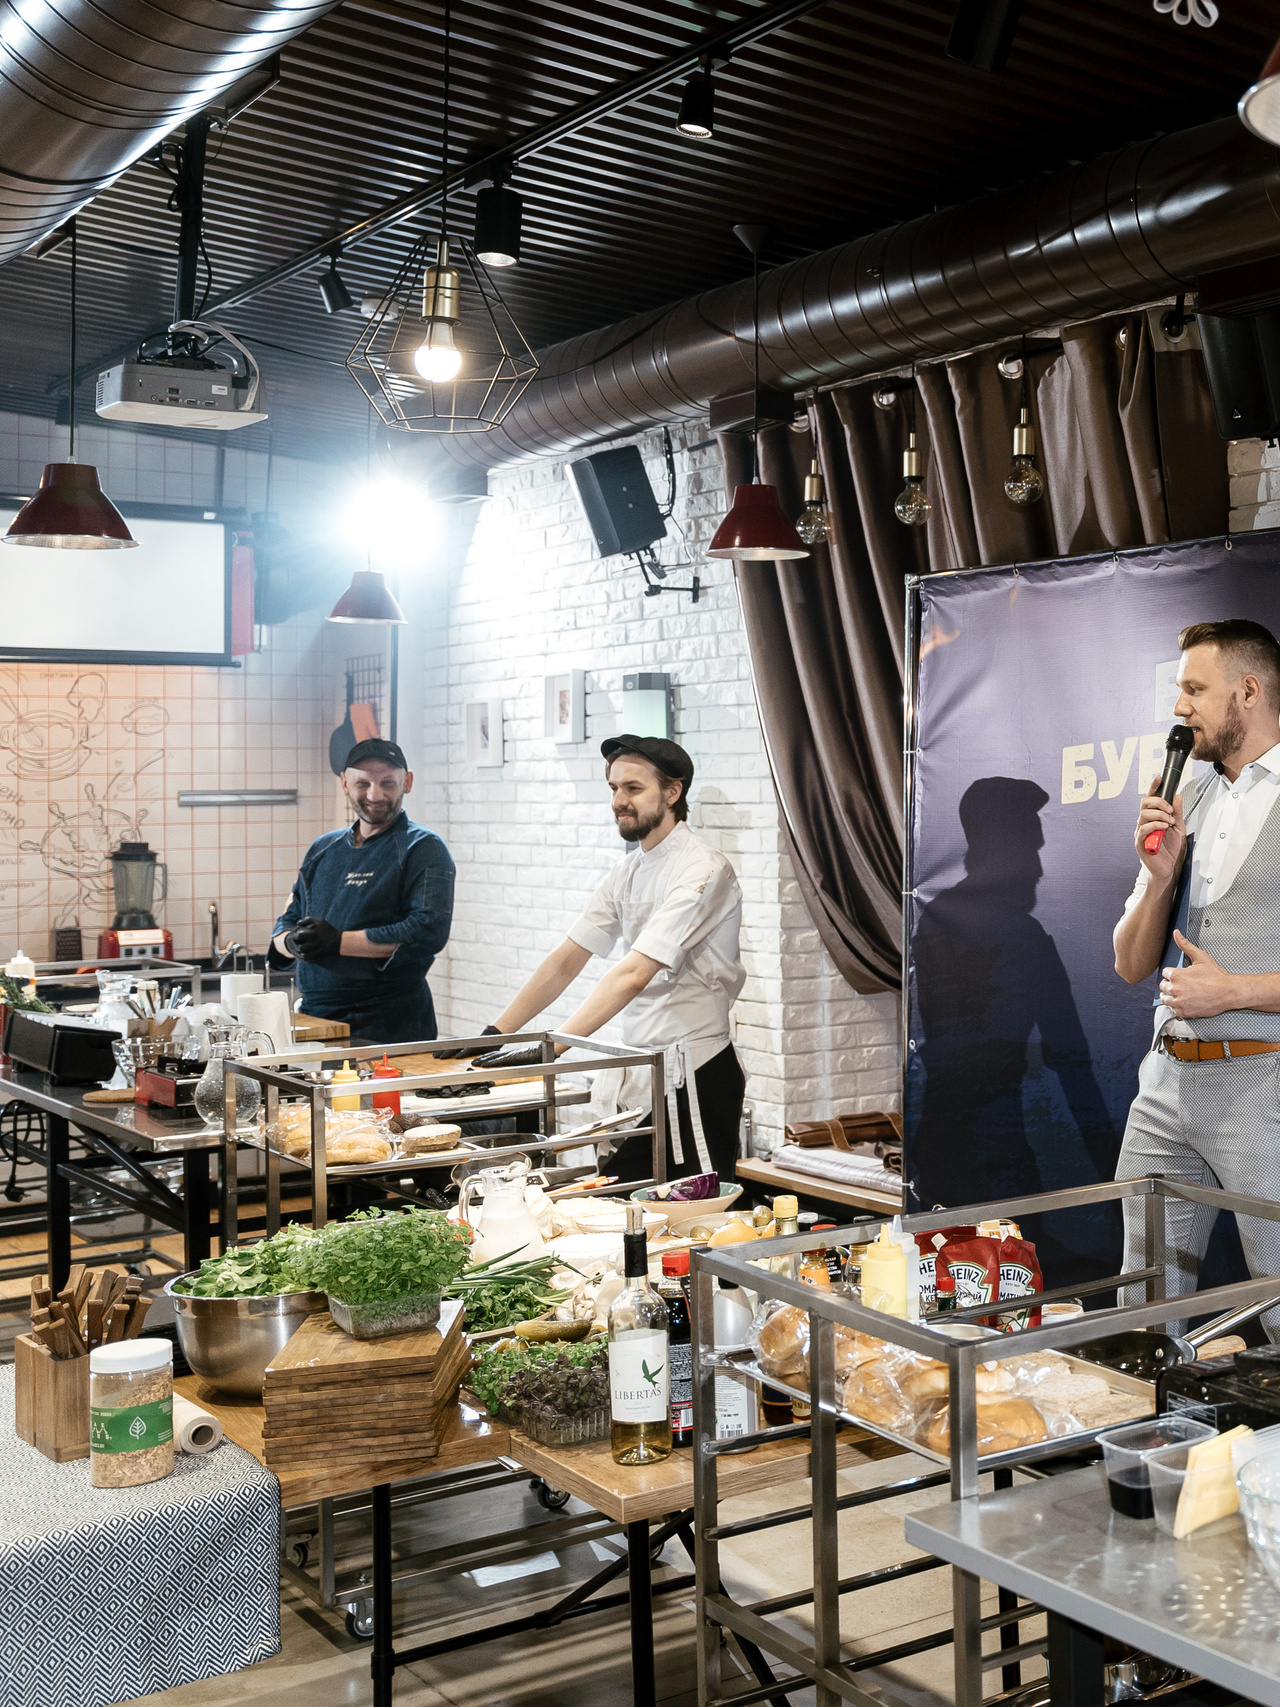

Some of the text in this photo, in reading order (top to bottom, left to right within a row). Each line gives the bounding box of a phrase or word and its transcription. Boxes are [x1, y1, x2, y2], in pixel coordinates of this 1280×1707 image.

[950, 1268, 980, 1284] HEINZ
[999, 1269, 1029, 1286] HEINZ
[614, 1386, 662, 1400] LIBERTAS
